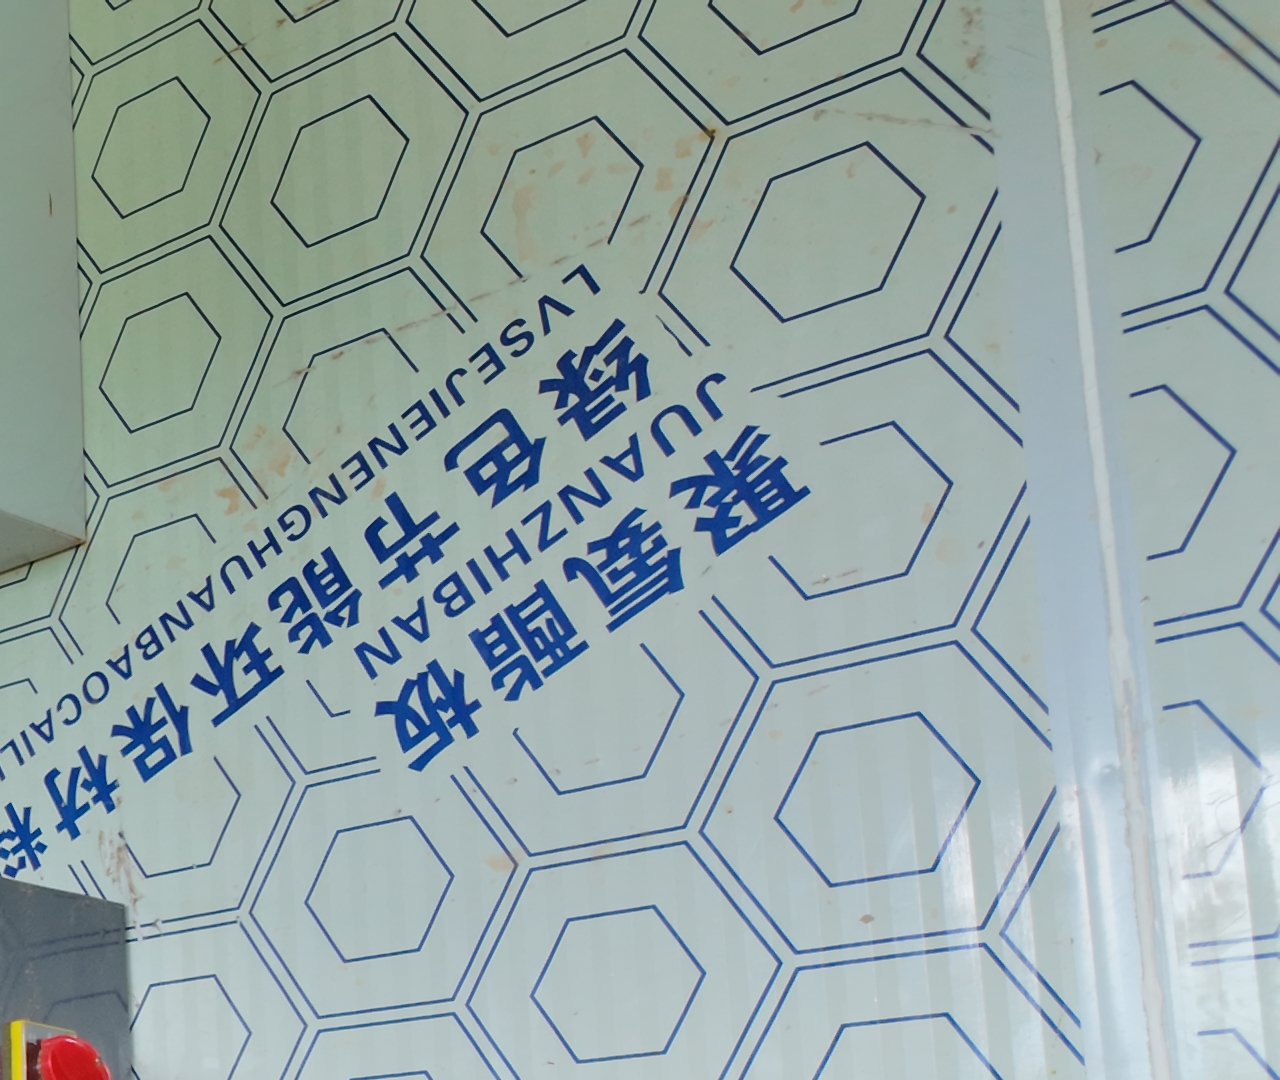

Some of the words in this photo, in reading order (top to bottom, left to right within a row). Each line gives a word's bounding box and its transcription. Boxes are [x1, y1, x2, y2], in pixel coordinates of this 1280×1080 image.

[354, 371, 729, 680] JUANZHIBAN
[374, 425, 813, 772] 聚氨酯板
